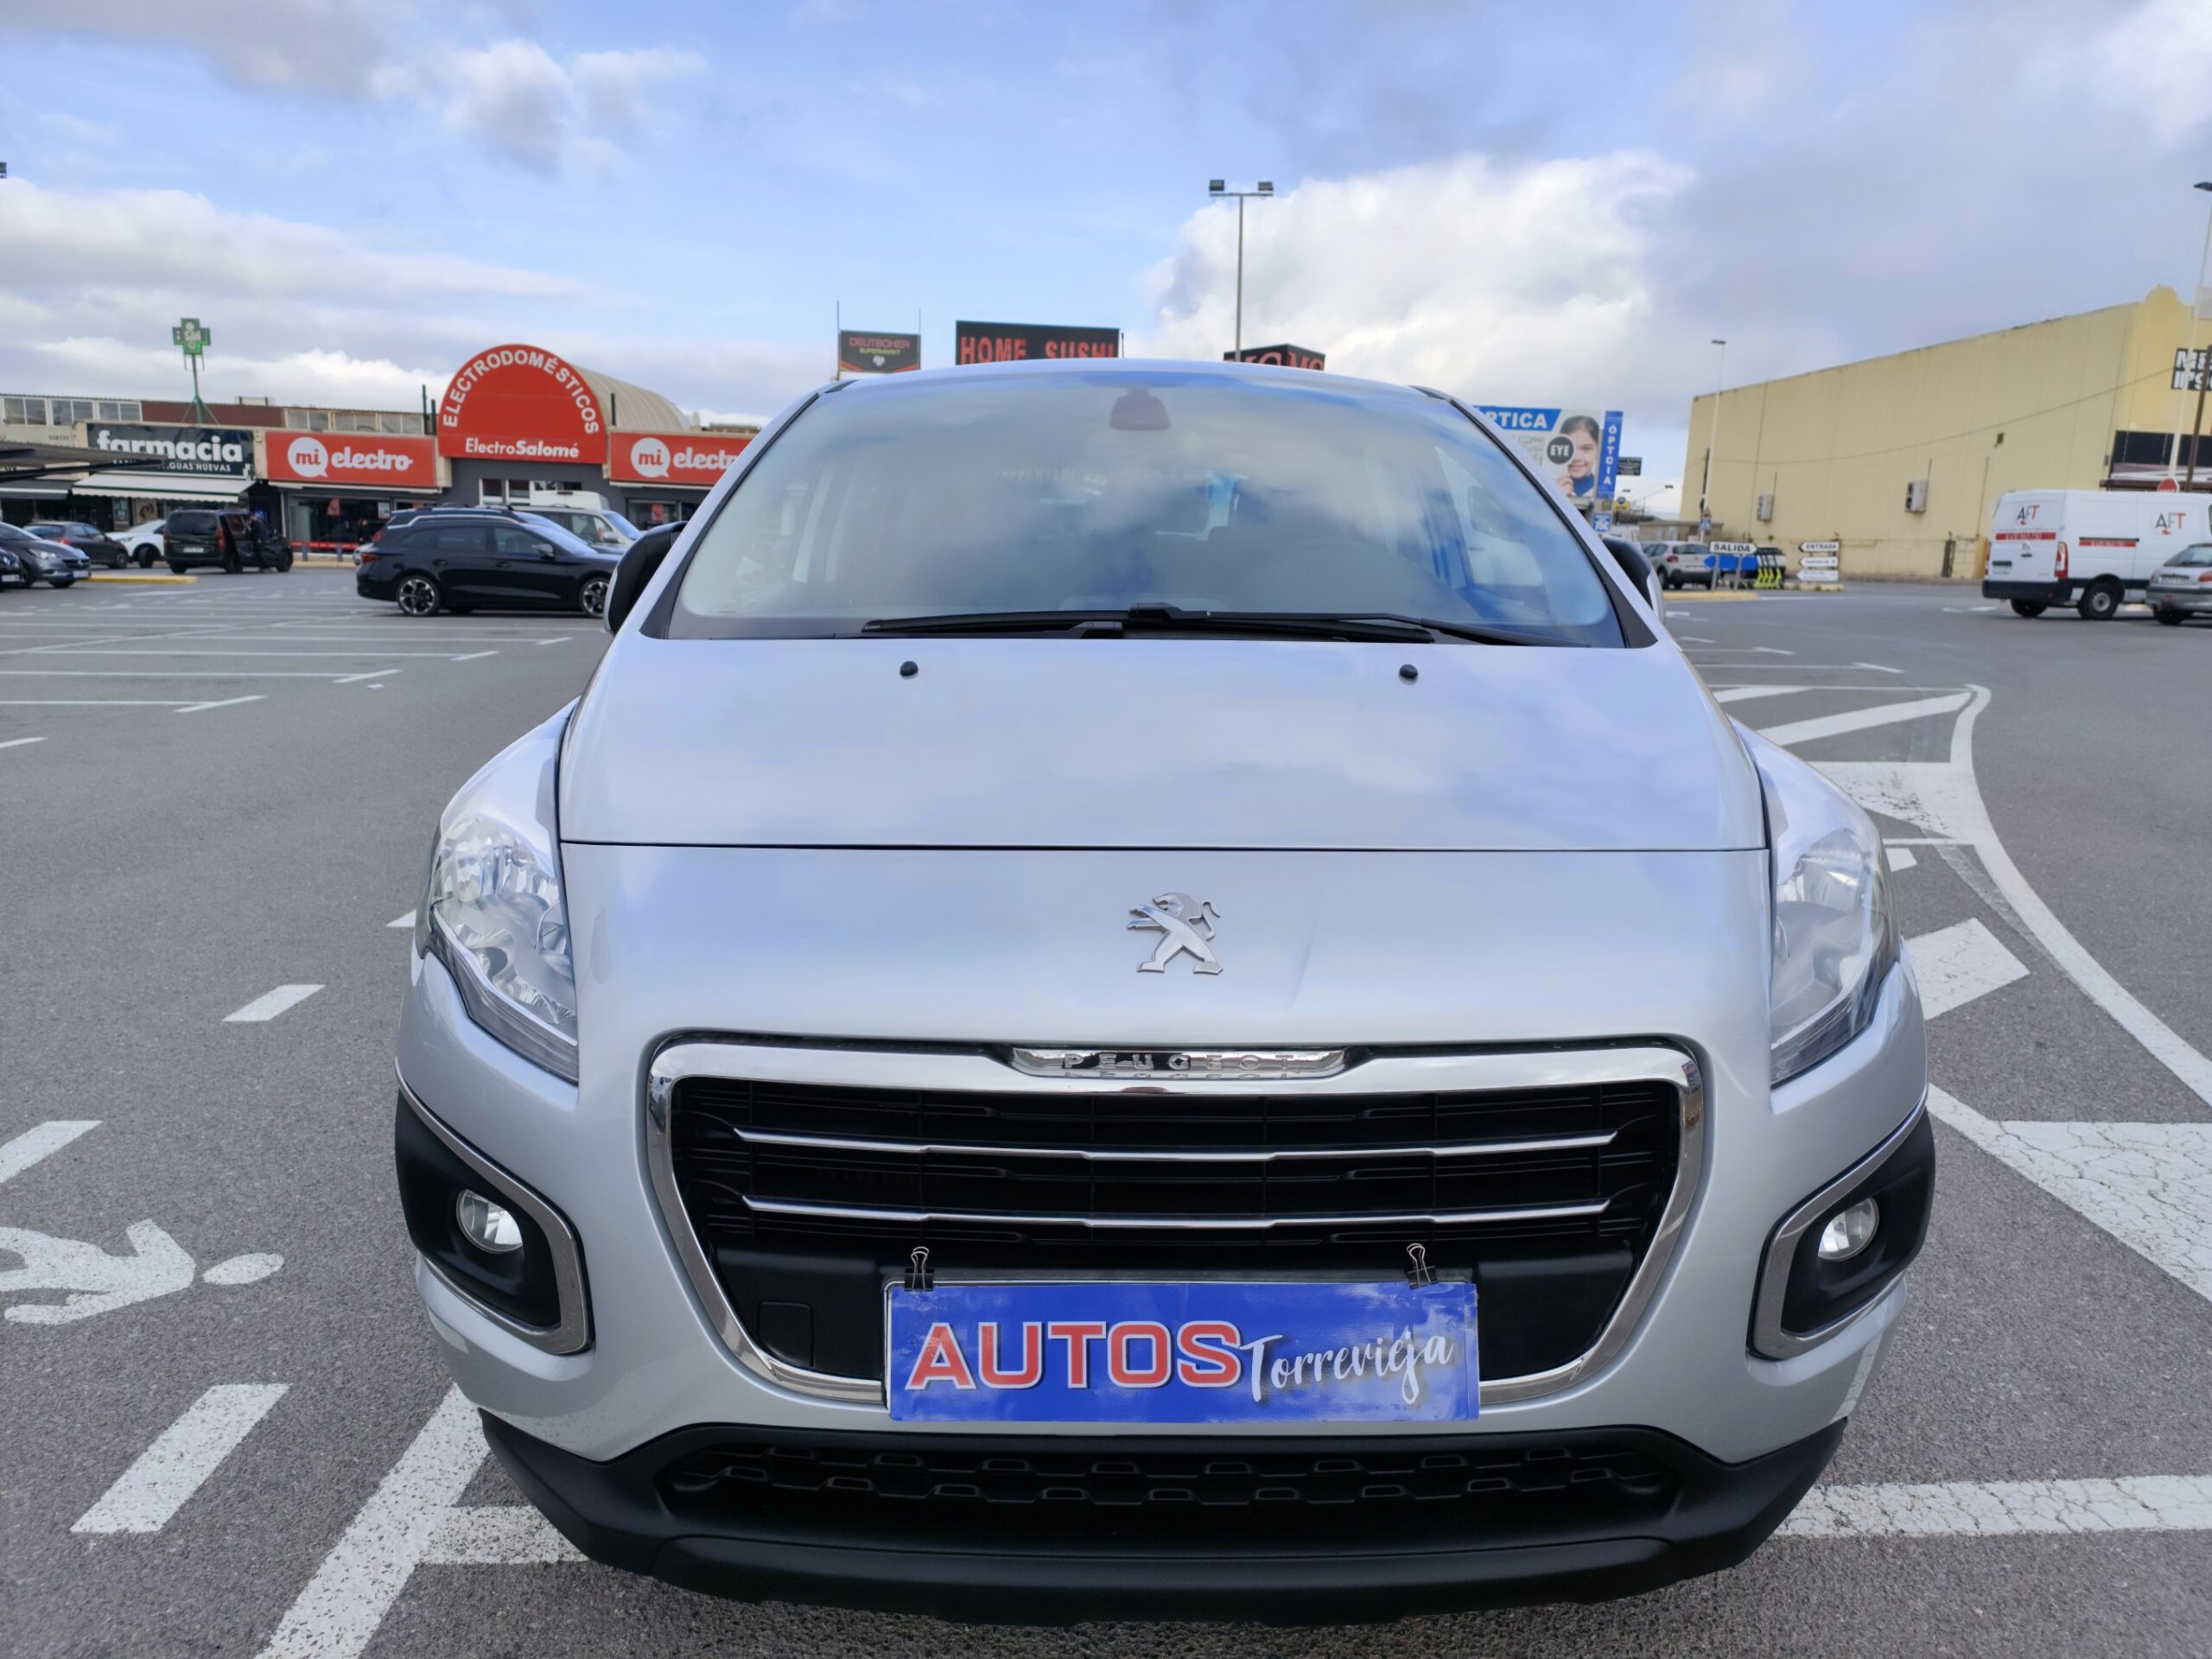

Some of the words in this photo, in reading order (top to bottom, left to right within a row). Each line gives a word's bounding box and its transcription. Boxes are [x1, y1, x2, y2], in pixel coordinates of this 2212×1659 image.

[849, 337, 911, 349] DEUTSCHER
[960, 336, 1027, 365] HOME
[442, 349, 600, 435] ELECTRODOMÉSTICOS
[1484, 410, 1548, 429] PTICA
[295, 448, 322, 466] mi
[331, 446, 414, 471] electro
[638, 449, 664, 466] mi
[673, 447, 739, 469] electr
[1550, 444, 1570, 456] EYE
[196, 463, 232, 473] NUEVAS
[1713, 543, 1751, 553] SALIDA
[1064, 1053, 1295, 1071] PEUGEOT
[905, 1320, 1243, 1389] AUTOS
[1239, 1331, 1455, 1404] Torrevieja
